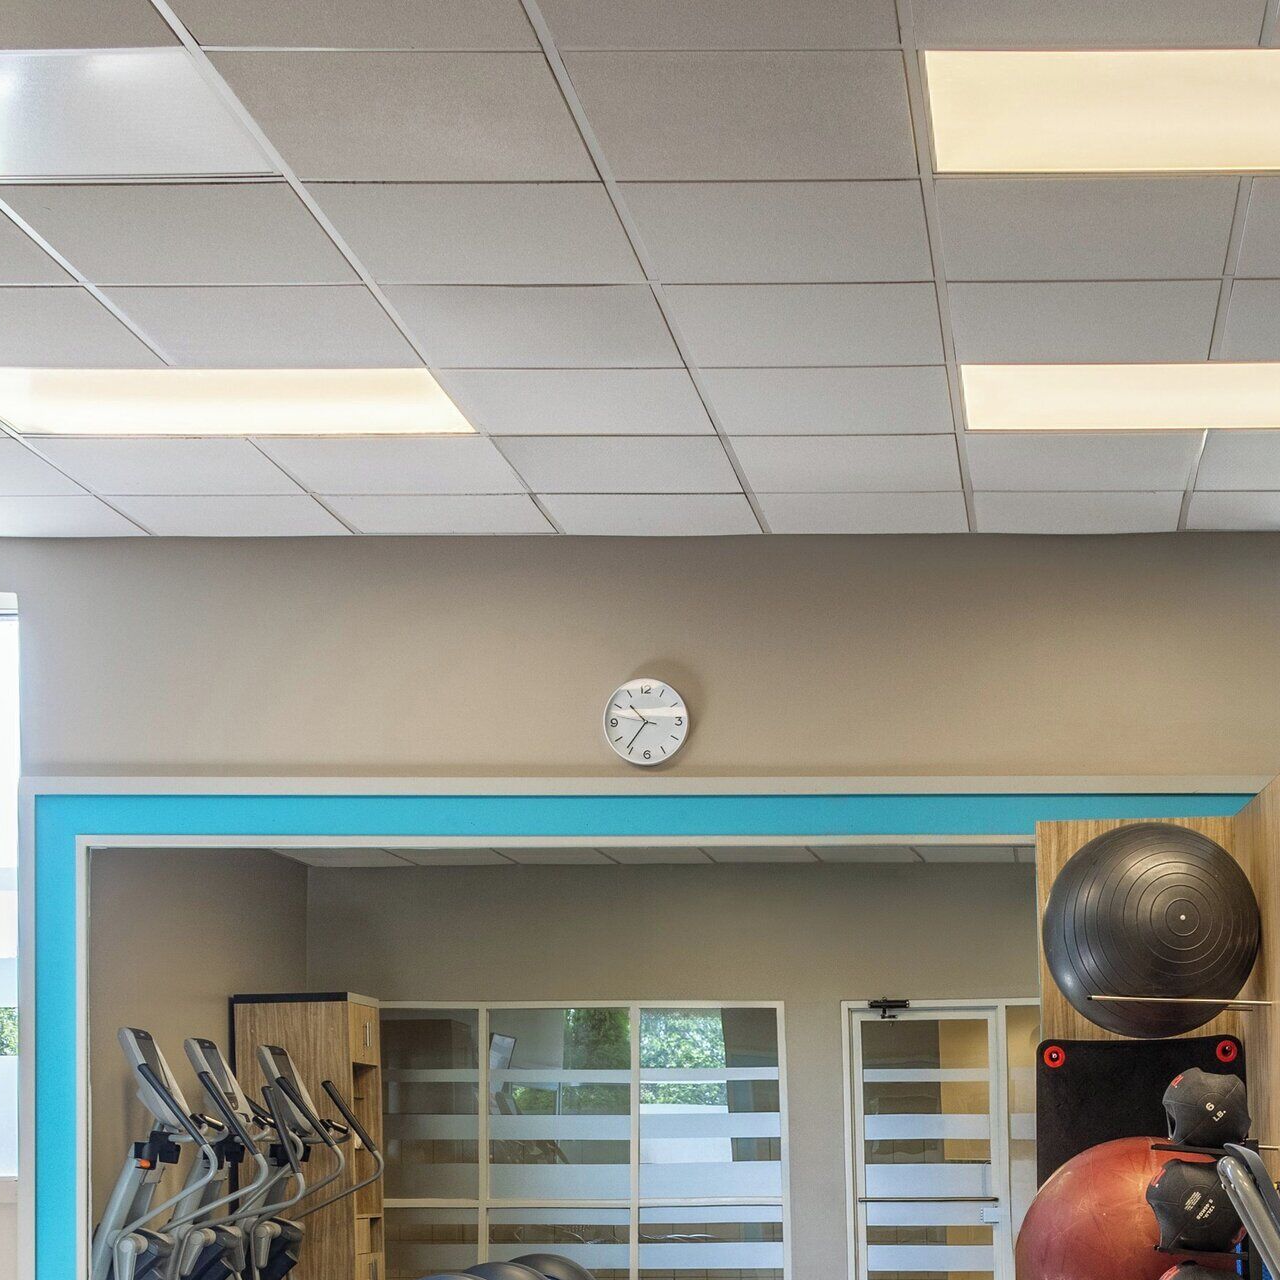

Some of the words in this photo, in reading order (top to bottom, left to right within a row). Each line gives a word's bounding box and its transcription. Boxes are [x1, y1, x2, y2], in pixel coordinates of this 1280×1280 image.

[641, 685, 652, 694] 12
[610, 718, 619, 728] 9
[674, 716, 683, 727] 3
[643, 750, 651, 760] 6
[1205, 1102, 1215, 1111] 6
[1213, 1110, 1226, 1121] LB.
